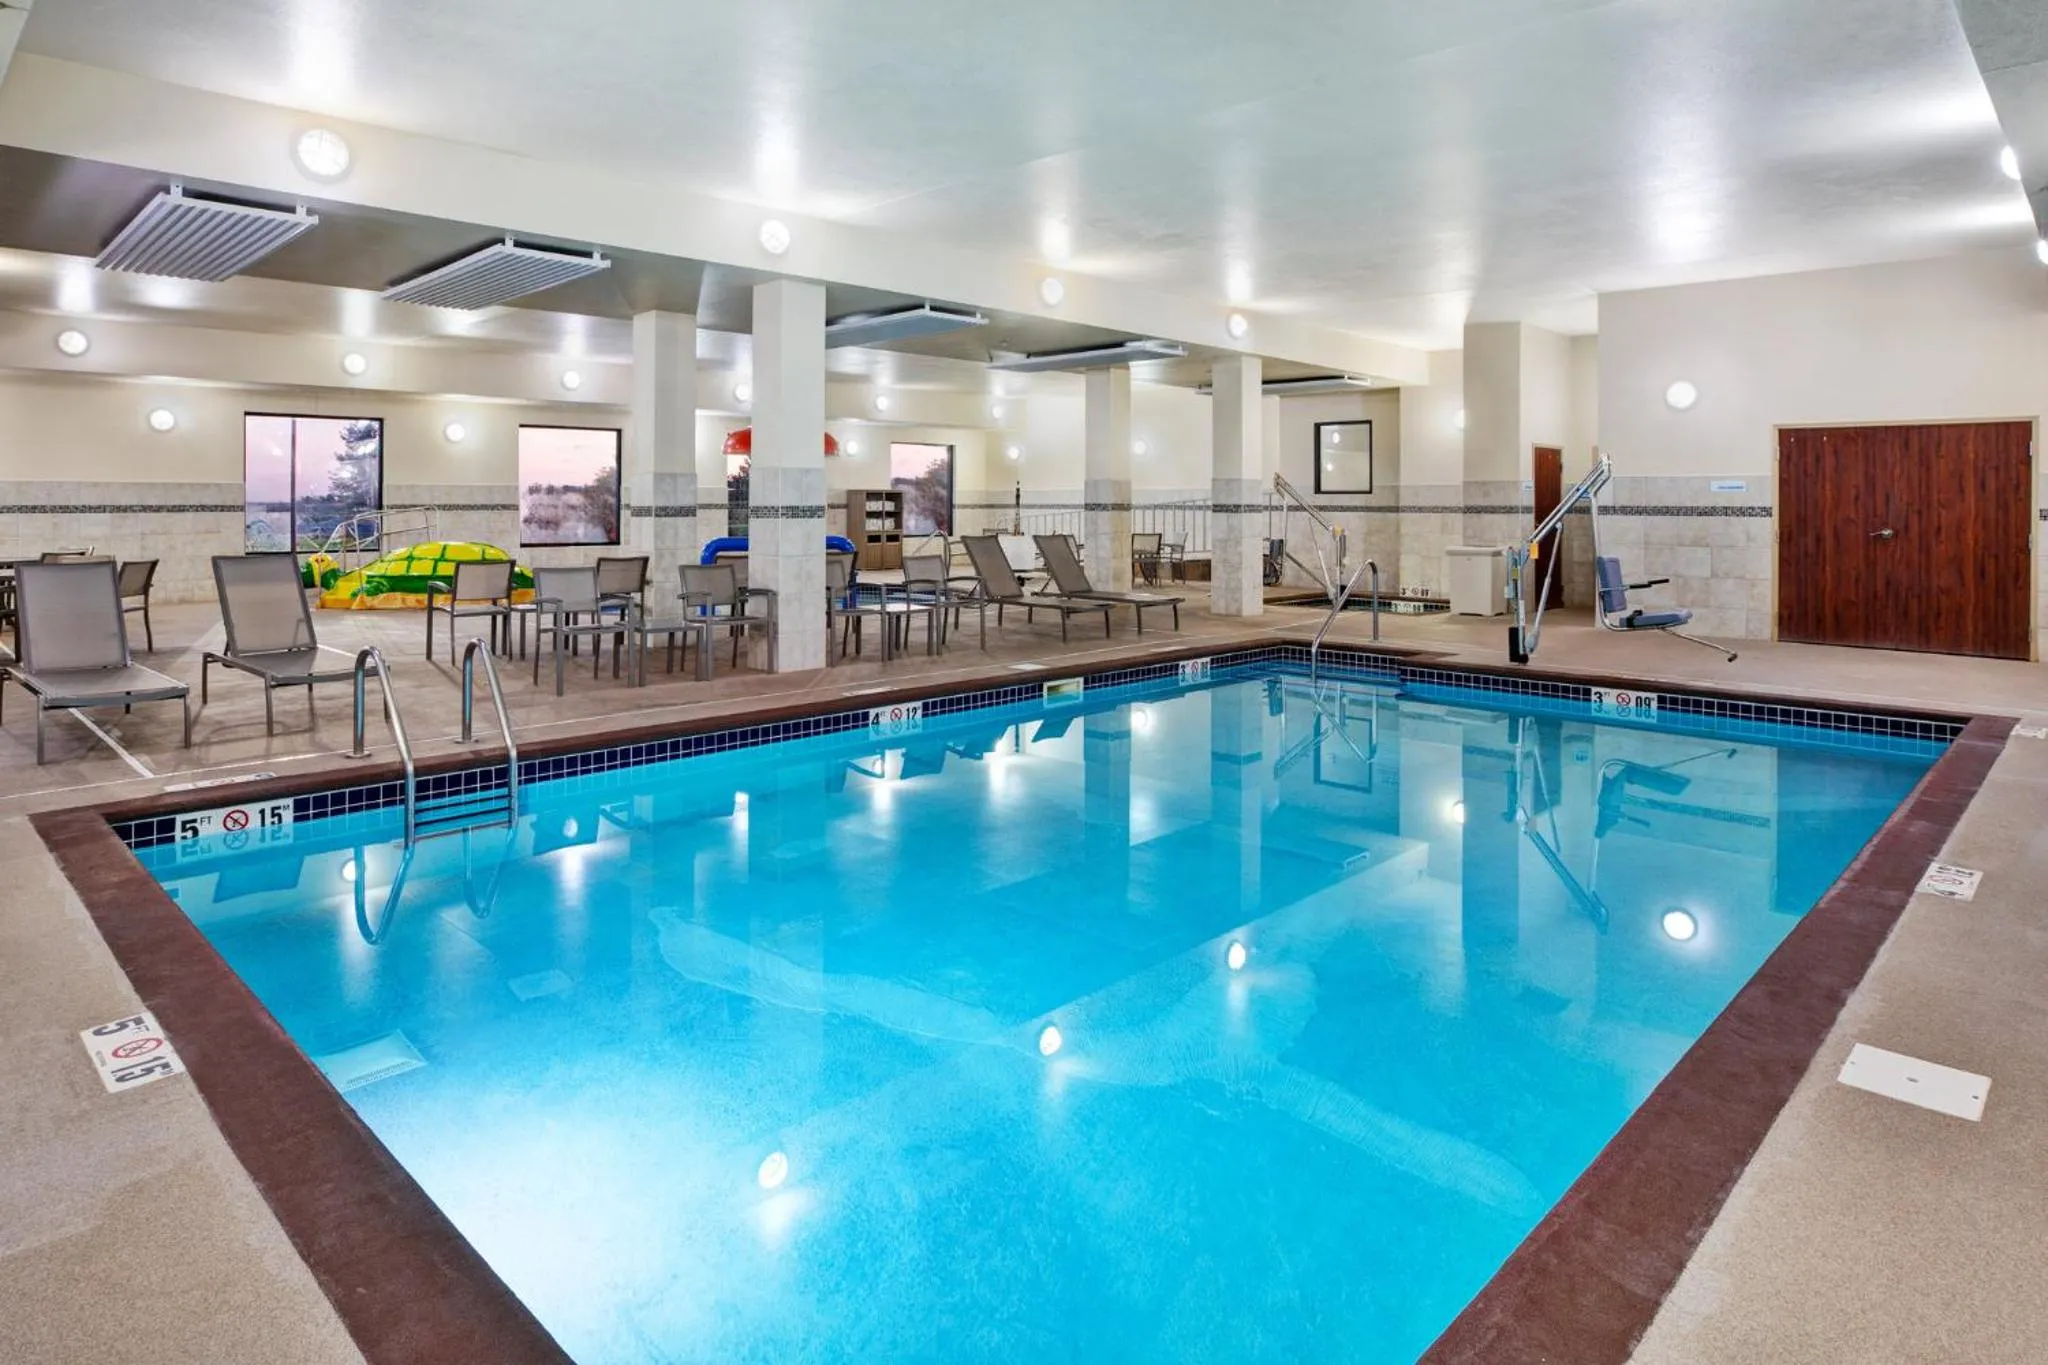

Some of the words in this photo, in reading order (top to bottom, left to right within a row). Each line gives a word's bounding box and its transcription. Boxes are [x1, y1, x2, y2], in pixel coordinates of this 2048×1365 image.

[1593, 691, 1604, 704] 3
[870, 711, 880, 726] 4
[906, 706, 918, 721] 12
[258, 805, 283, 828] 15
[180, 818, 200, 841] 5
[200, 816, 213, 827] FT
[92, 1016, 147, 1036] 5
[110, 1055, 172, 1083] 15
